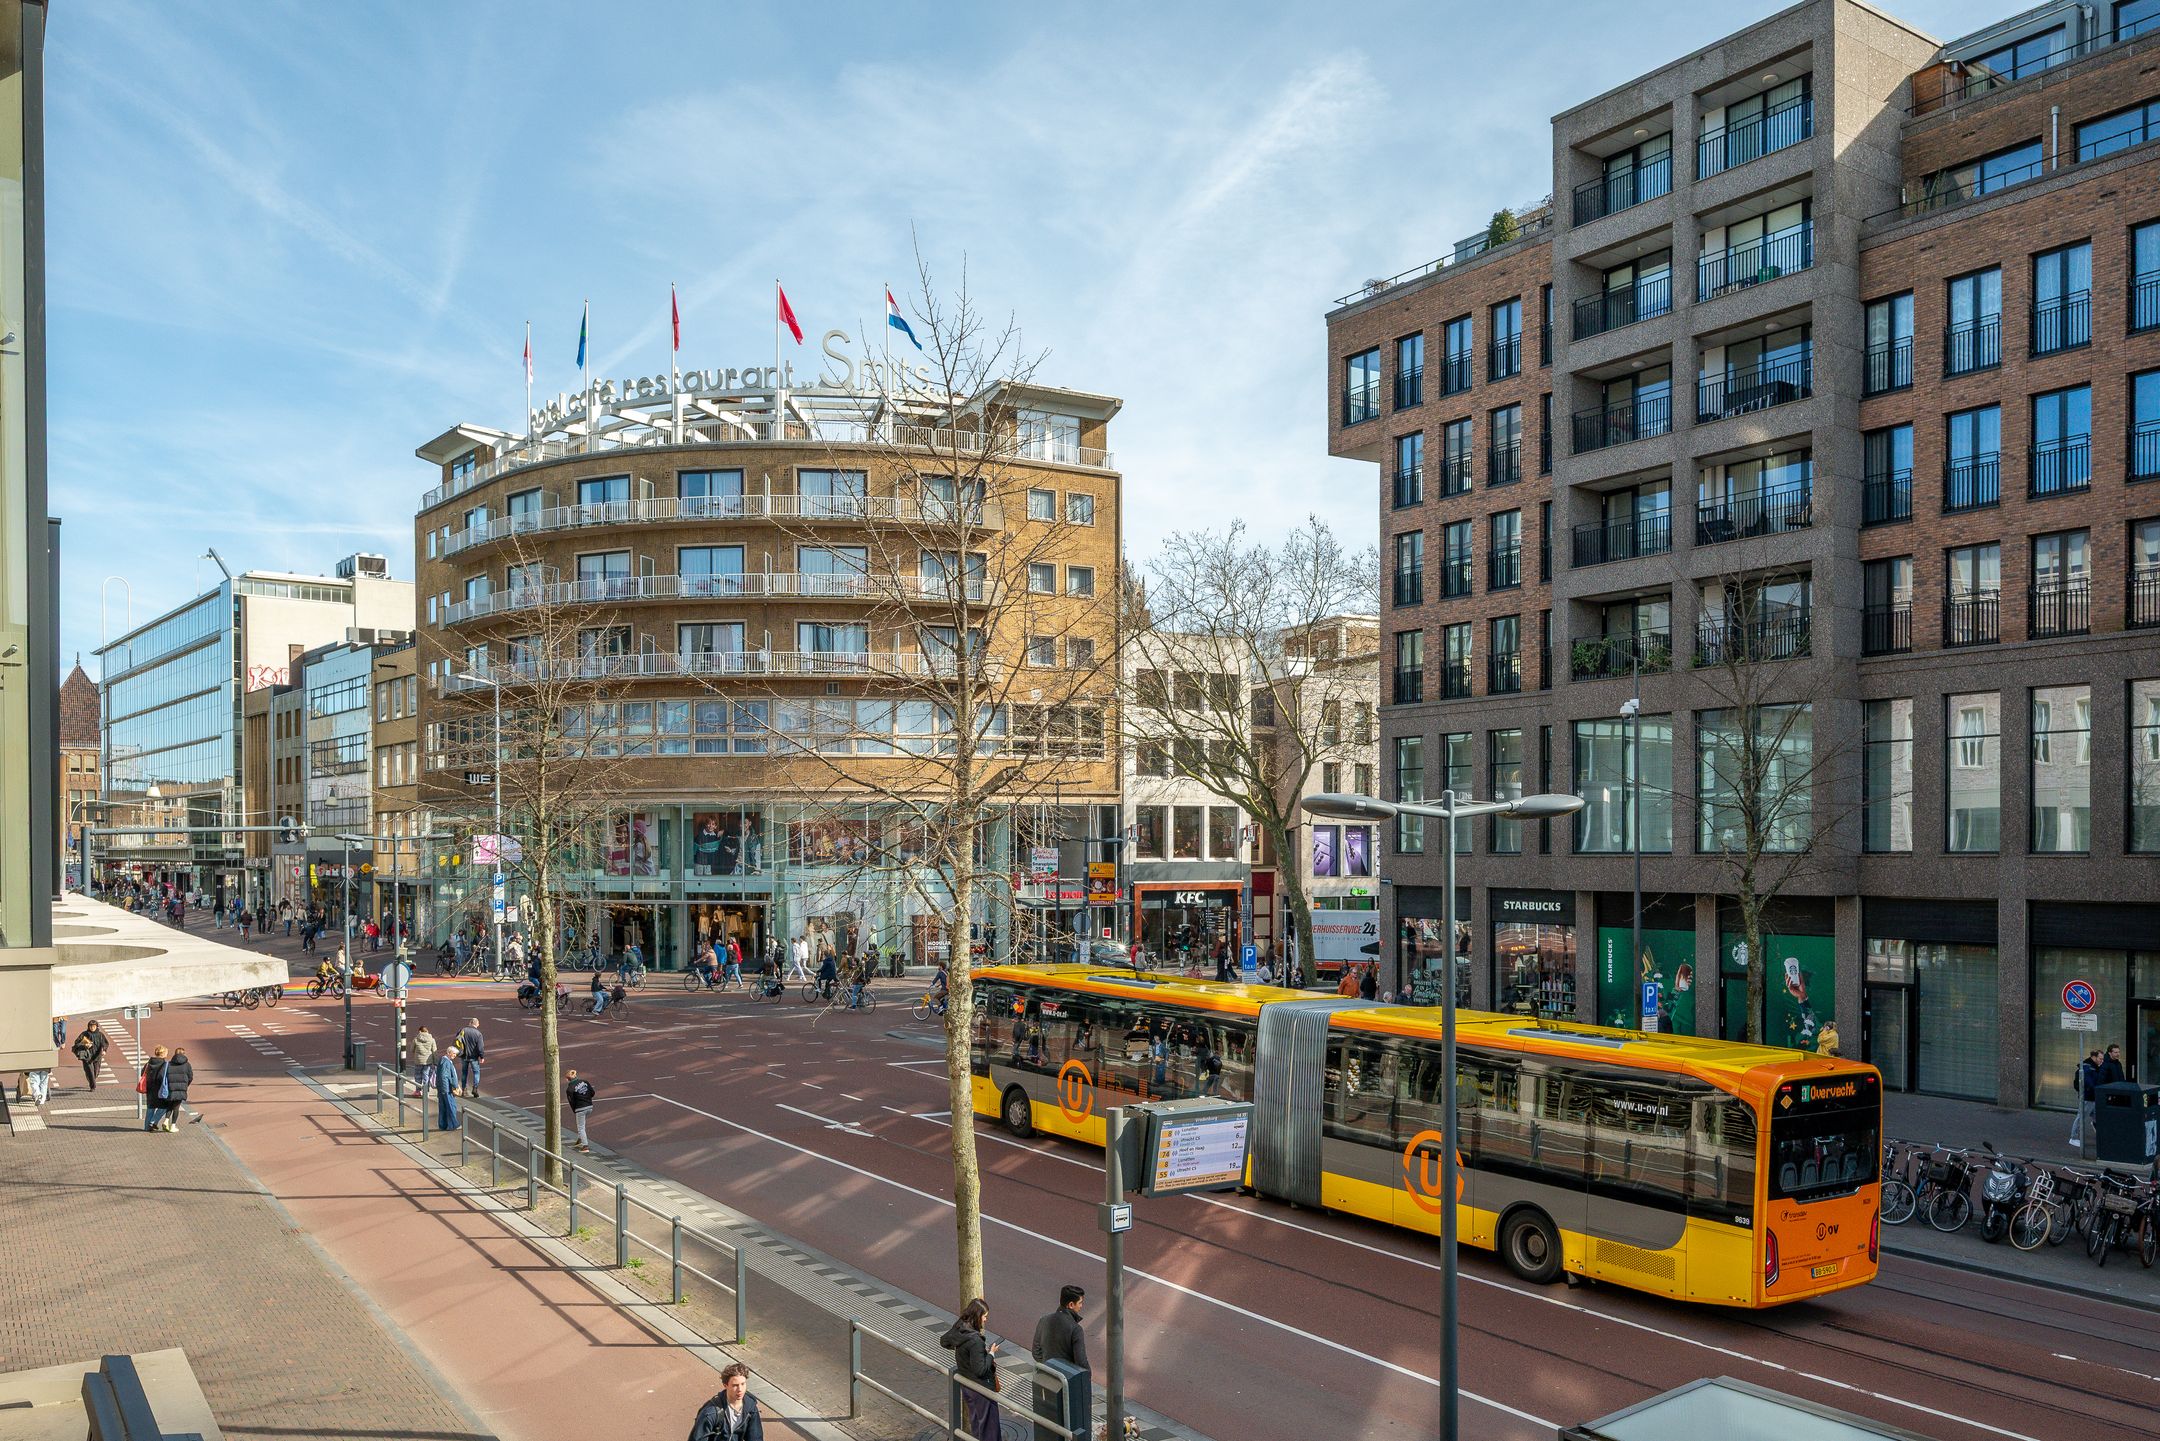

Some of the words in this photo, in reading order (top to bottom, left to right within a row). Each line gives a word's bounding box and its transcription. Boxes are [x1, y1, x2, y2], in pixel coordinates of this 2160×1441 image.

[623, 359, 794, 400] restaurant
[819, 329, 930, 392] Smits
[469, 774, 491, 784] WE
[1174, 891, 1205, 904] KFC
[1504, 901, 1561, 911] STARBUCKS
[1312, 925, 1362, 934] ERHUISSERVICE
[1362, 922, 1376, 936] 24
[1246, 949, 1253, 961] P
[1647, 986, 1654, 1003] P
[1810, 1082, 1856, 1100] Overvecht
[1614, 1100, 1668, 1116] www.u-ov.nl
[1828, 1224, 1839, 1235] OV
